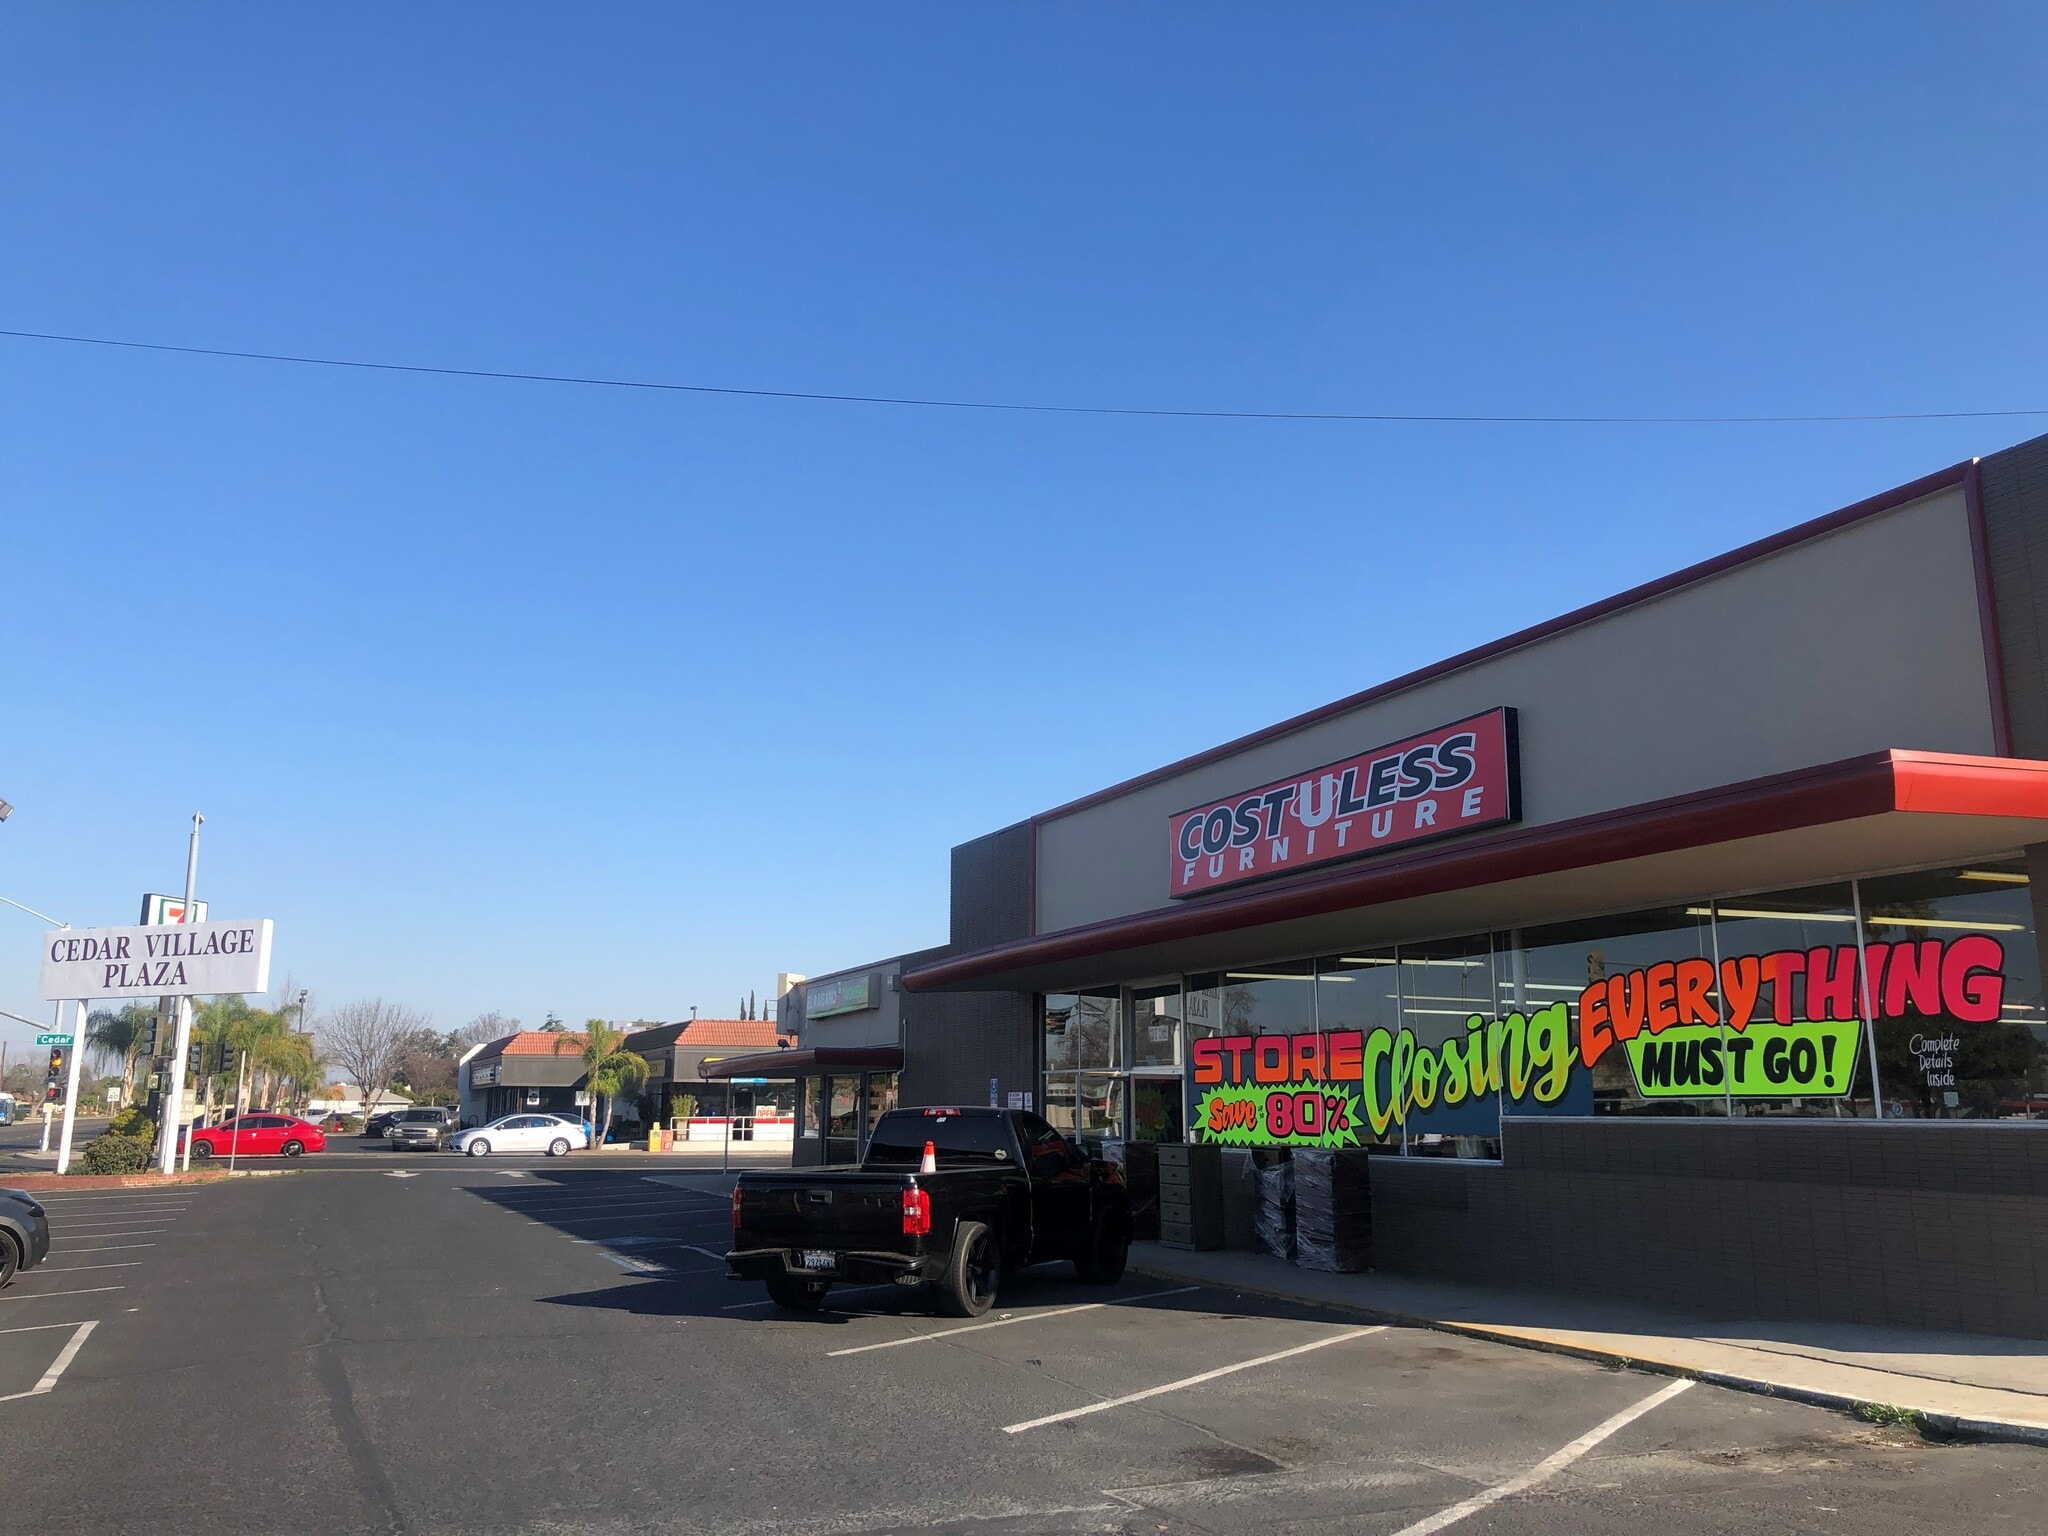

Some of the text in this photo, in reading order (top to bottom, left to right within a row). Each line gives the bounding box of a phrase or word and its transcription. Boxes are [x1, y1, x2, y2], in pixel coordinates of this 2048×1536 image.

[1183, 786, 1484, 885] FURNITURE
[51, 929, 254, 963] CEDAR VILLAGE
[103, 961, 187, 988] PLAZA
[1578, 934, 2004, 1069] EVERYTHING
[41, 1035, 71, 1044] Cedar
[1909, 1032, 1960, 1054] Complete
[1194, 1001, 1579, 1138] STORE Closing
[1642, 1034, 1837, 1087] MUST GO!
[1918, 1052, 1953, 1071] Details
[1927, 1069, 1955, 1087] Inside
[1208, 1097, 1258, 1133] Save
[1265, 1091, 1349, 1138] 80%
